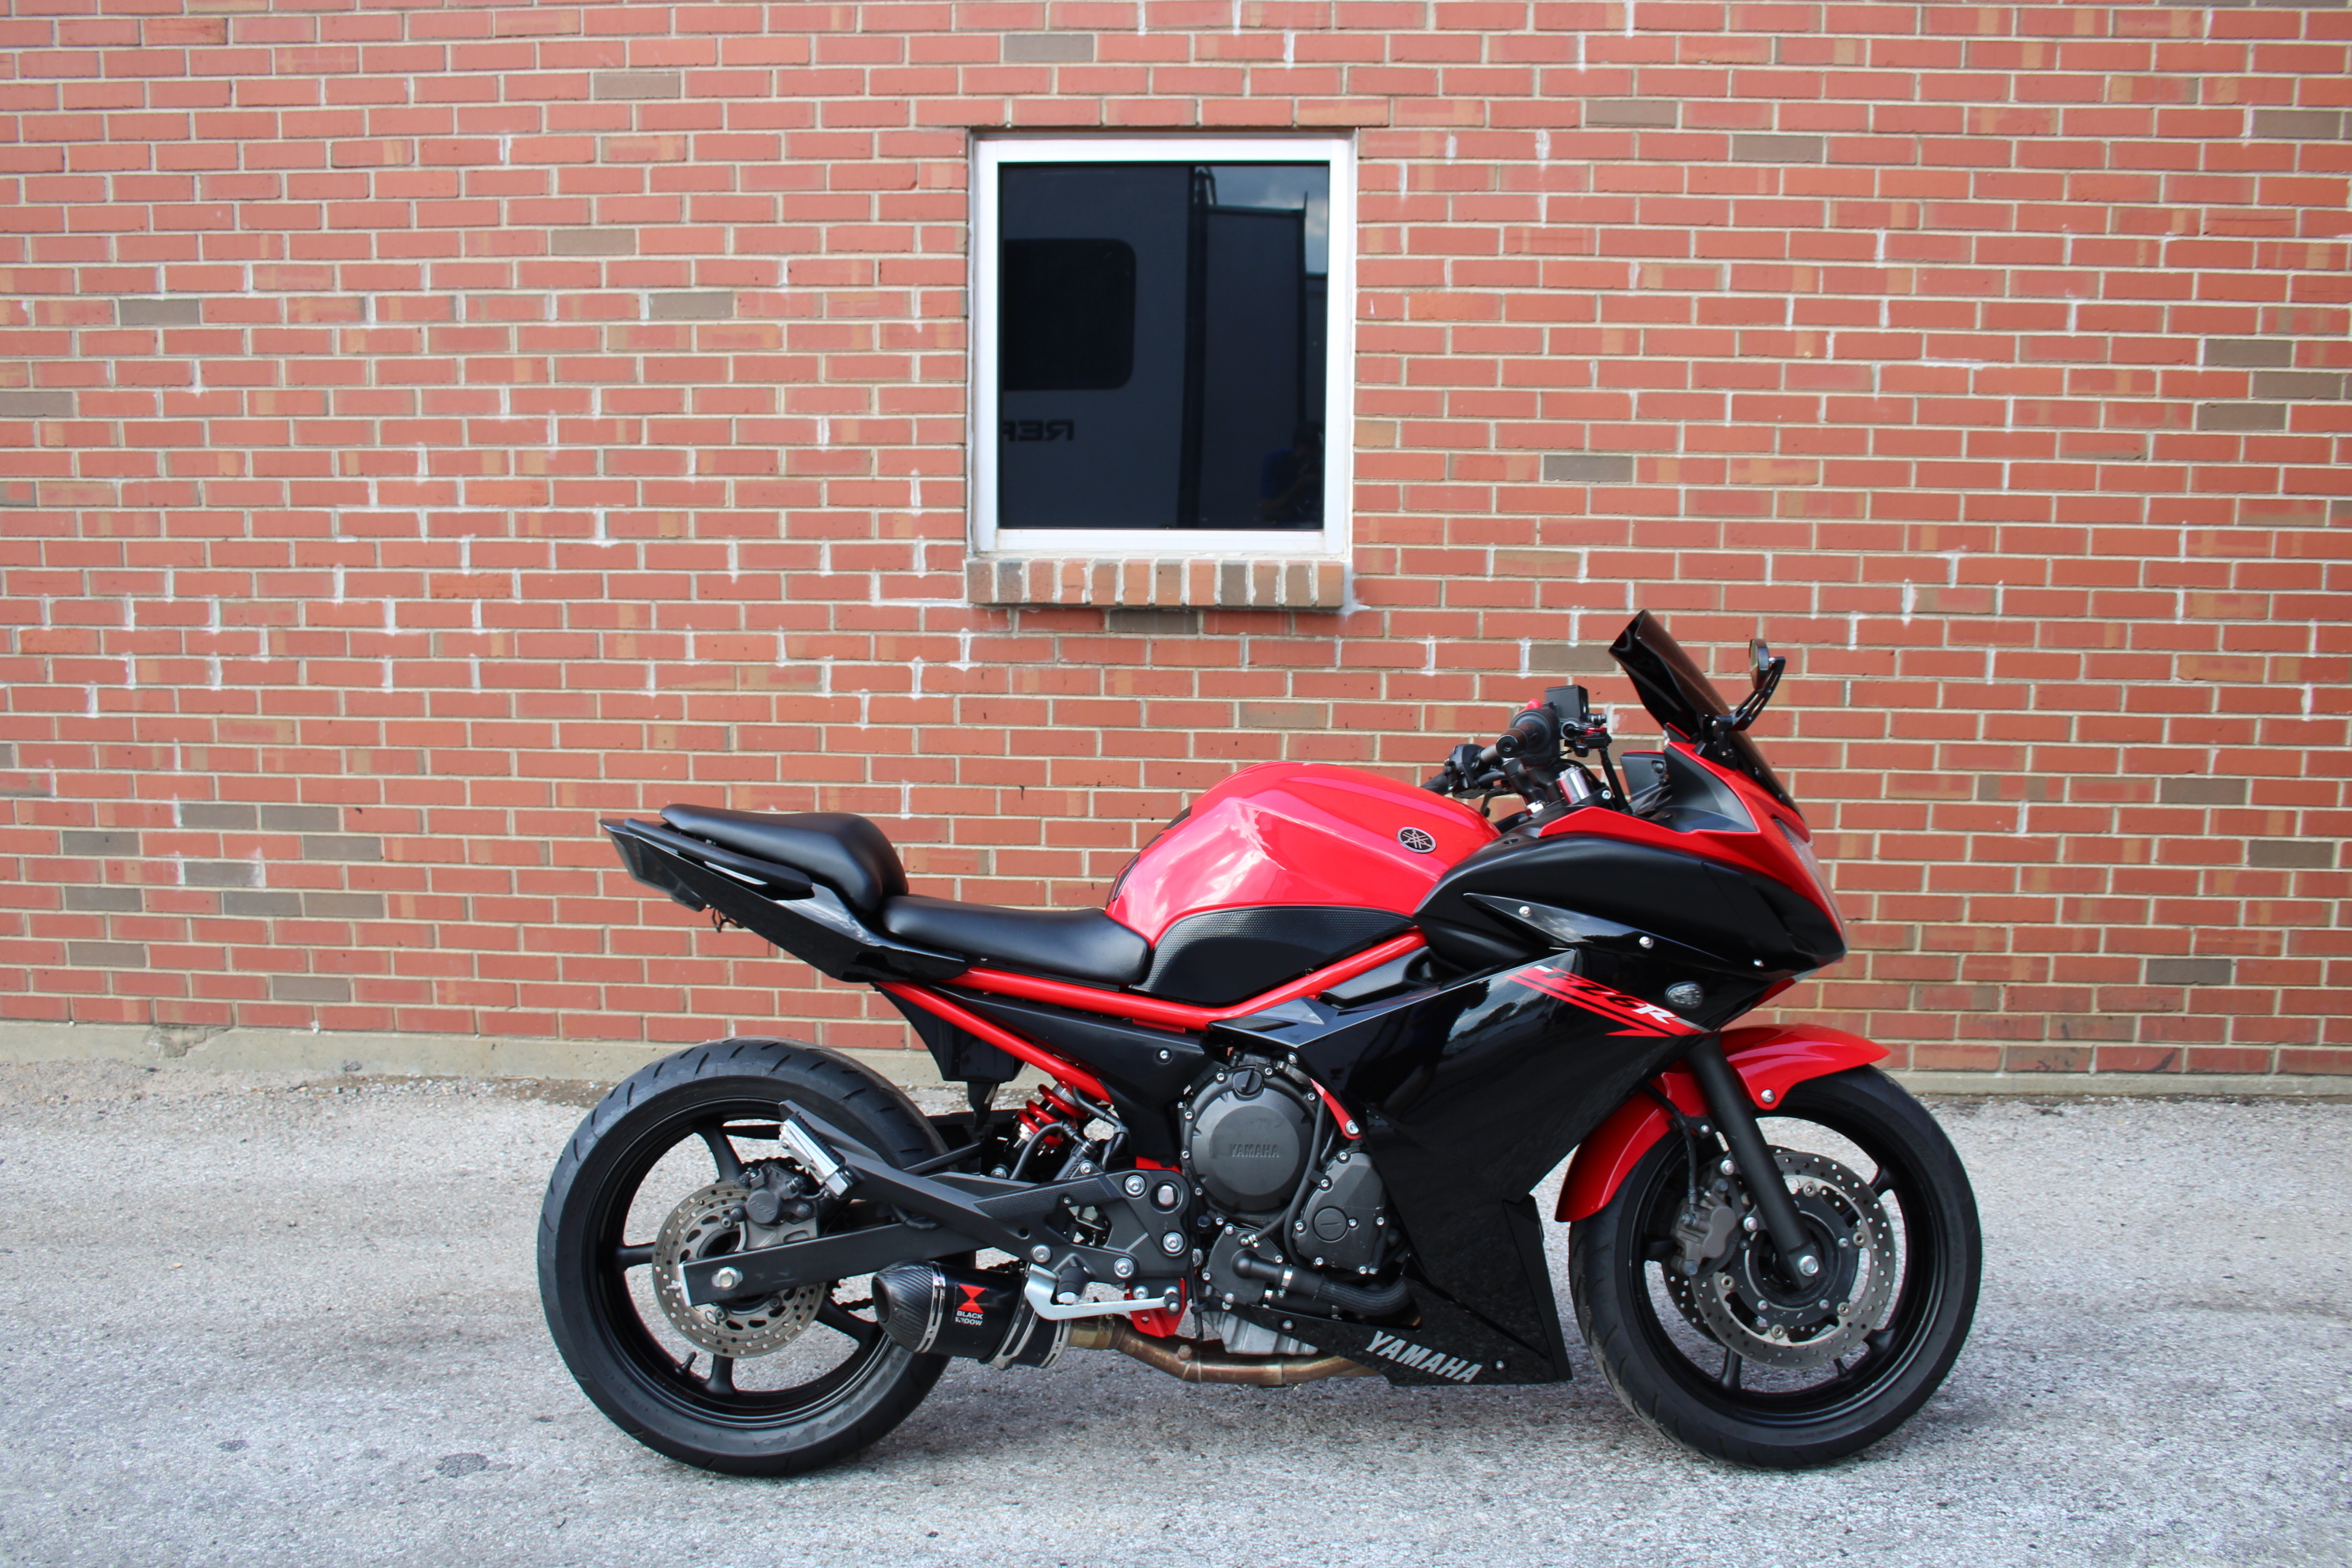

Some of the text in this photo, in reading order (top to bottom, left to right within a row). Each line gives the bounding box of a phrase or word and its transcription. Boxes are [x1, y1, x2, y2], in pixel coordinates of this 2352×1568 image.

[1229, 1144, 1280, 1158] YAMAHA
[956, 1310, 984, 1320] BLACK
[1365, 1329, 1483, 1383] YAMAHA
